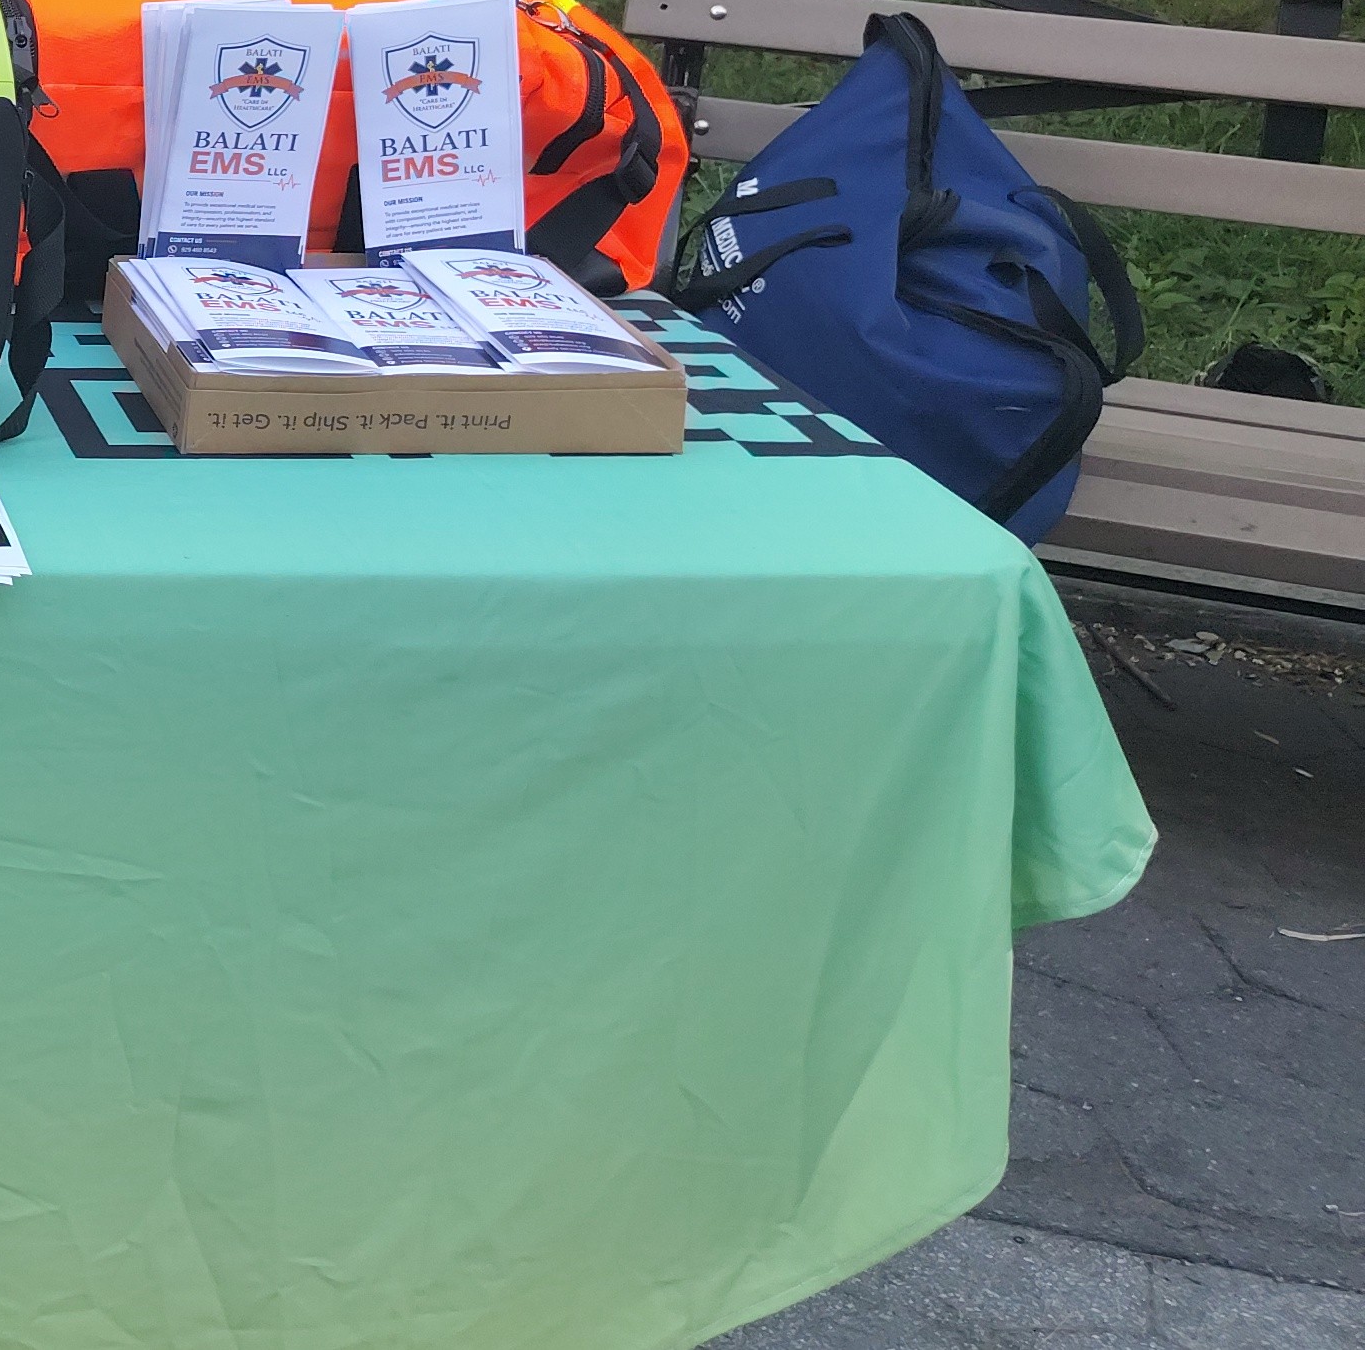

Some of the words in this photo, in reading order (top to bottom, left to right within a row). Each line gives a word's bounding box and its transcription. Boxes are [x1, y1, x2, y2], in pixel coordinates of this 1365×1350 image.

[193, 130, 300, 151] BALATI
[379, 128, 489, 157] BALATI
[189, 150, 266, 176] EMS
[267, 168, 288, 177] LLC
[381, 153, 460, 183] EMS
[464, 164, 485, 174] LLC
[195, 292, 303, 310] BALATI
[469, 290, 580, 305] BALATI
[477, 298, 562, 310] EMS
[200, 300, 281, 312] EMS
[352, 320, 435, 329] EMS
[207, 413, 227, 429] it.
[233, 413, 270, 429] Get
[278, 414, 297, 430] it.
[303, 412, 349, 431] Ship
[356, 414, 373, 430] it.
[380, 413, 428, 429] Pack
[436, 414, 456, 430] it.
[461, 414, 511, 430] Print
